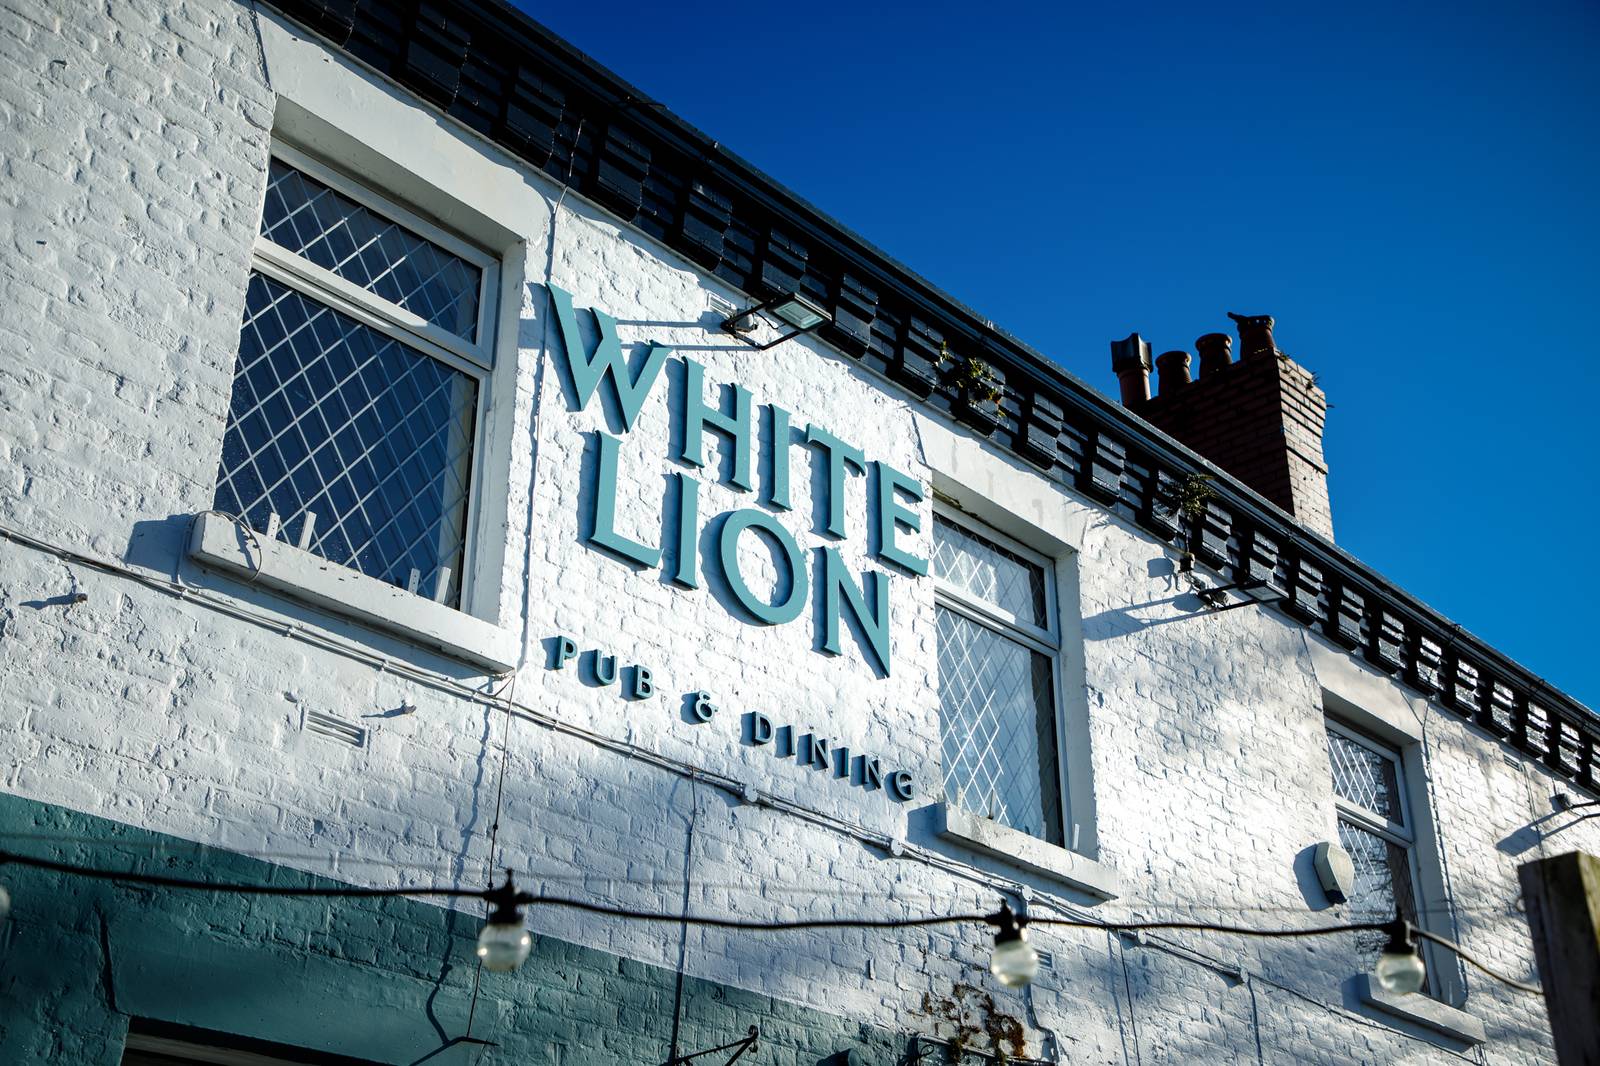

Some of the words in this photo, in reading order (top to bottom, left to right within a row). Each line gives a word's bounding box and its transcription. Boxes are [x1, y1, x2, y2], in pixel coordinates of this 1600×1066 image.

[546, 281, 929, 577] WHITE
[588, 429, 890, 679] LION
[554, 635, 654, 700] PUB
[694, 689, 719, 724] &
[751, 711, 914, 801] DINING
